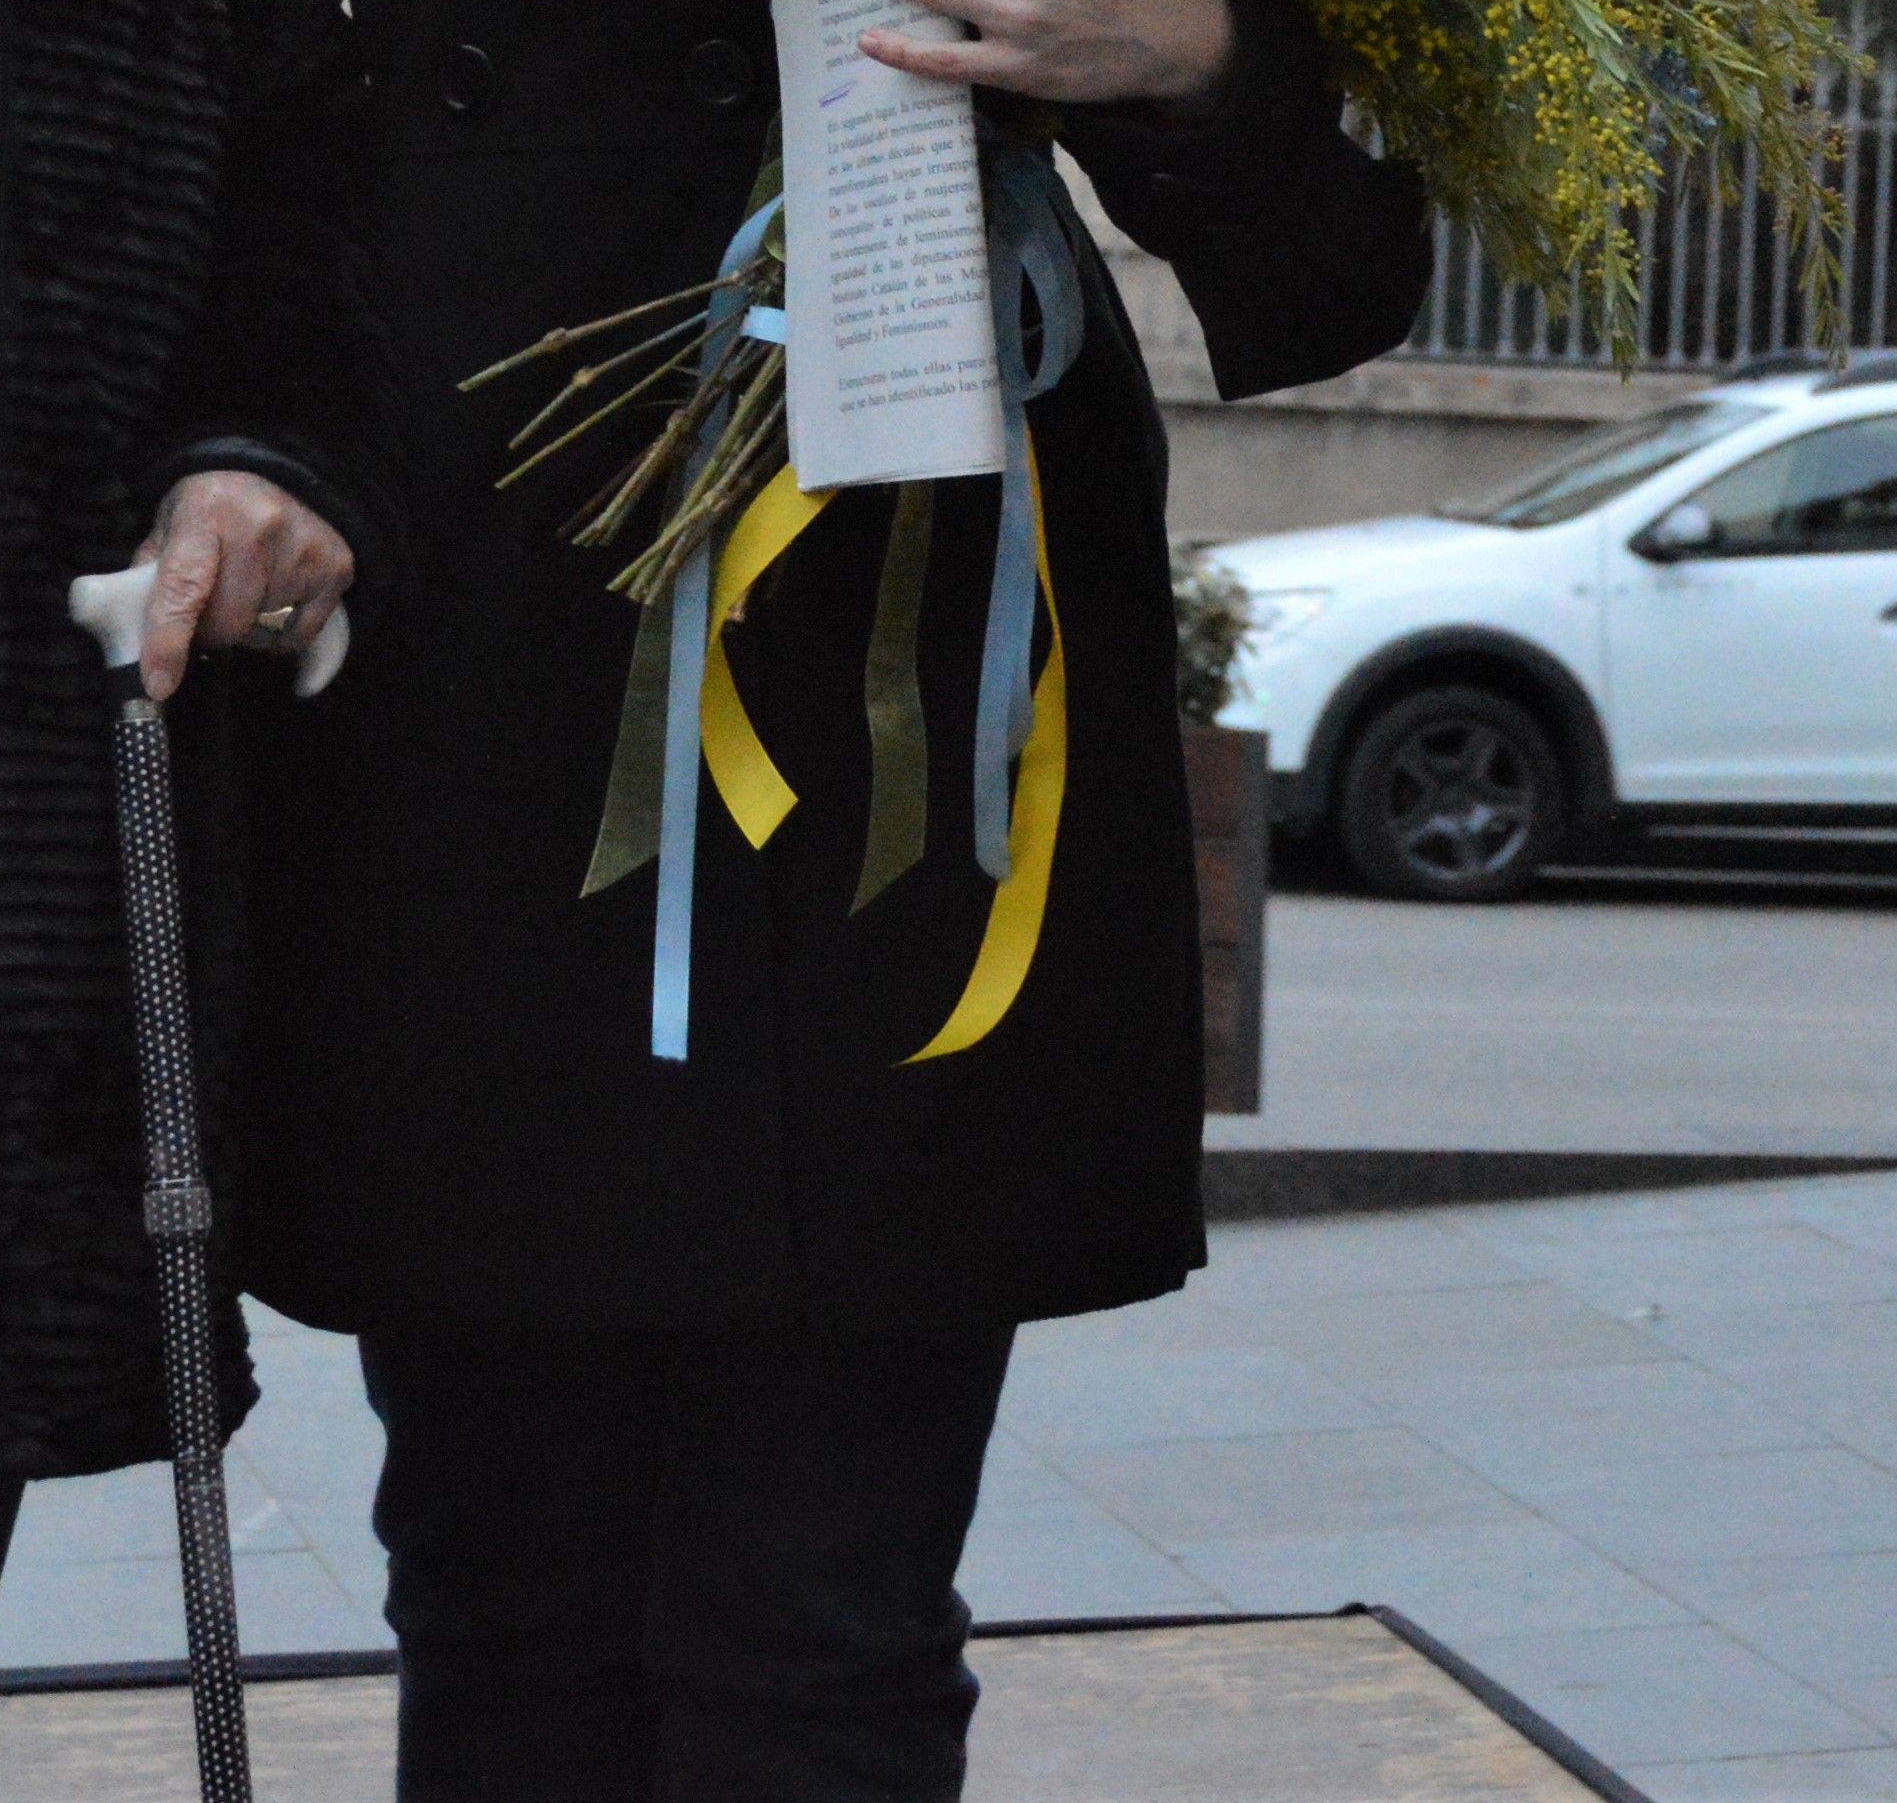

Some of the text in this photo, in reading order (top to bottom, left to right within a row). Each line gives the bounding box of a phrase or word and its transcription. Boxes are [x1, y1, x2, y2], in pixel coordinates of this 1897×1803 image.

[930, 139, 954, 155] que
[923, 359, 953, 376] ellas
[960, 378, 978, 392] las
